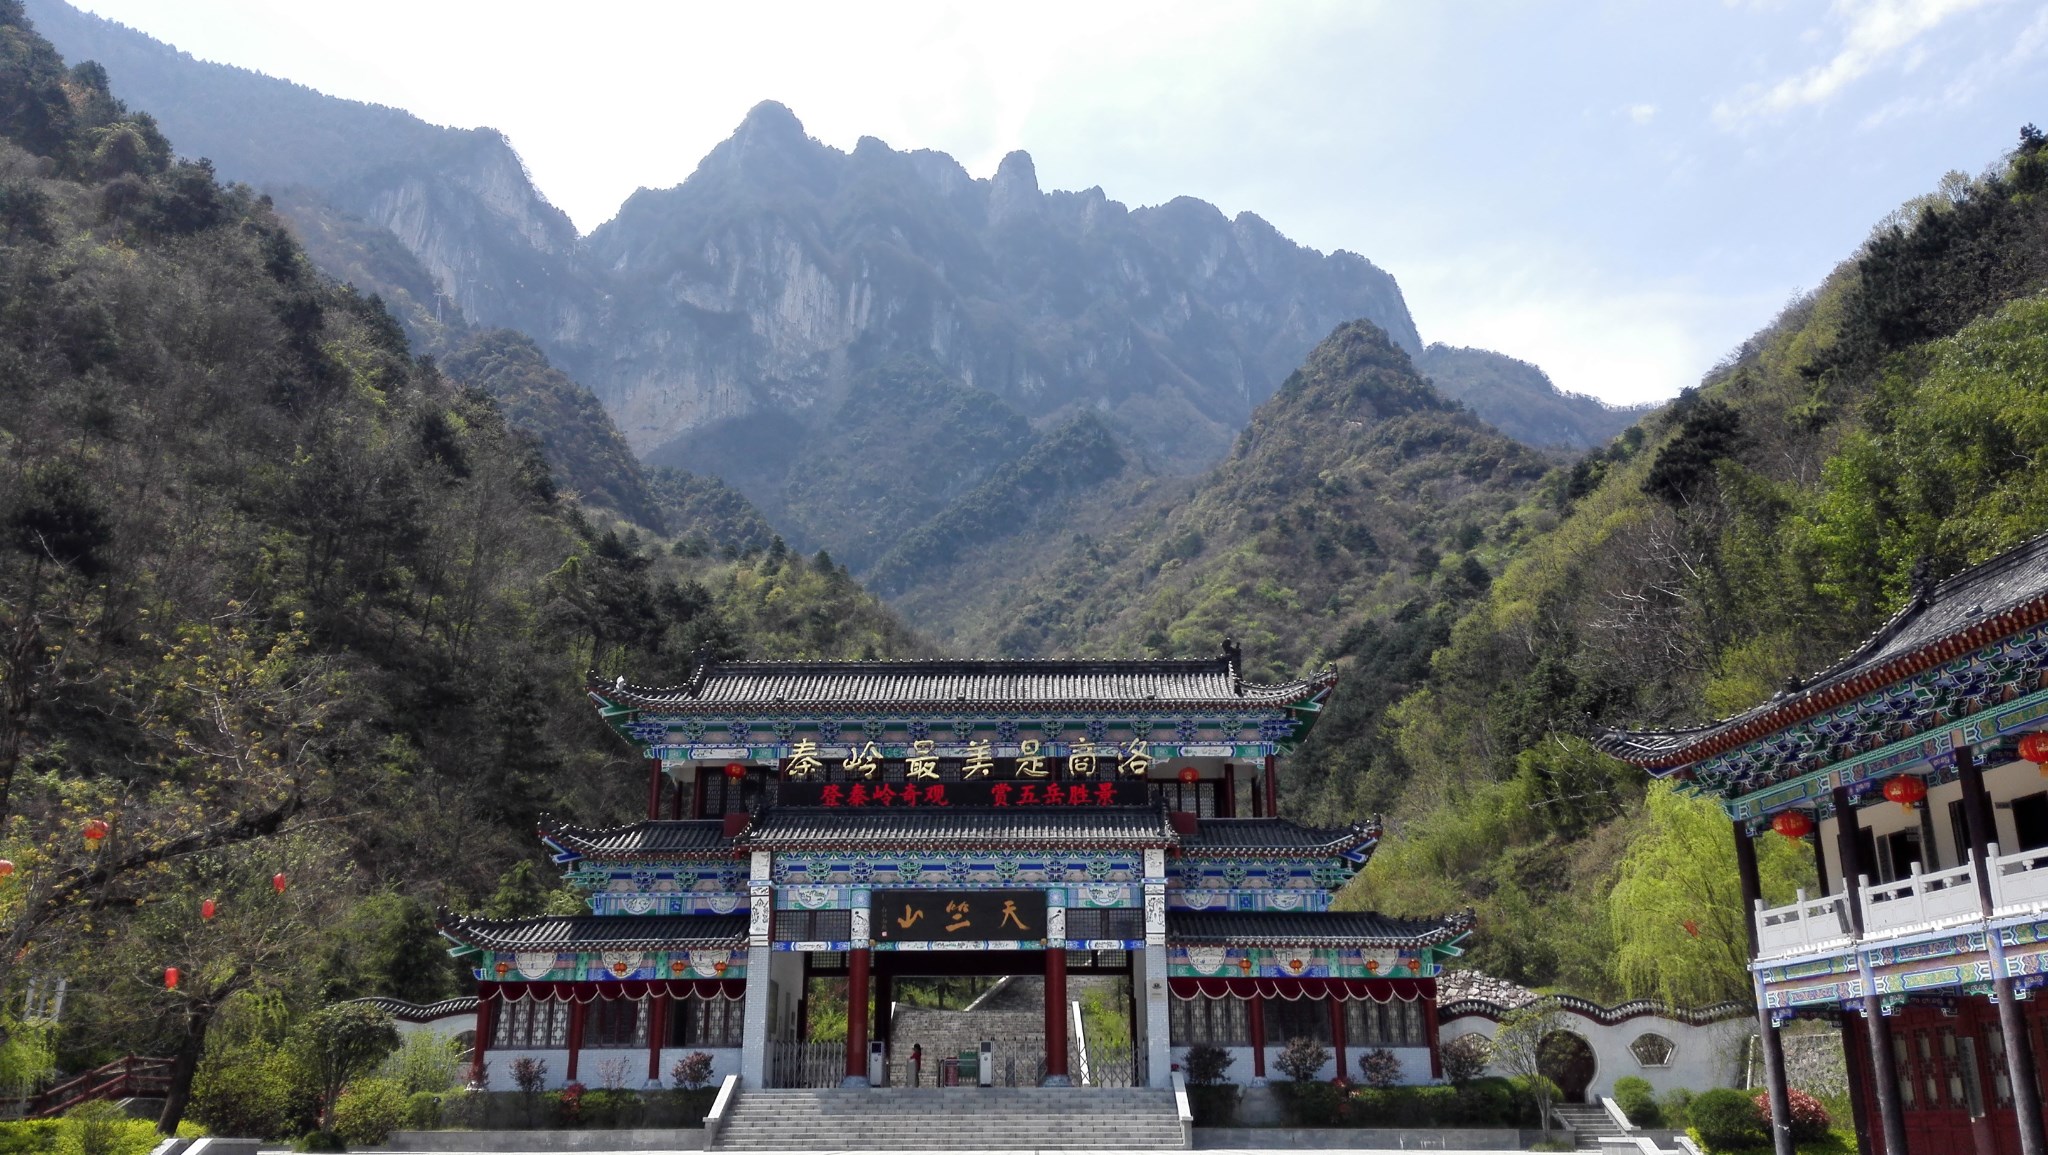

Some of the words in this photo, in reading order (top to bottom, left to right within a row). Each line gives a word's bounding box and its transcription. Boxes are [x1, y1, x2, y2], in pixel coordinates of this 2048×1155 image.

[784, 737, 1152, 780] 秦岭最美是商洛
[820, 783, 950, 807] 登秦岭奇观
[991, 782, 1118, 807] 赏五岳胜景
[897, 900, 1031, 932] 天竺山
